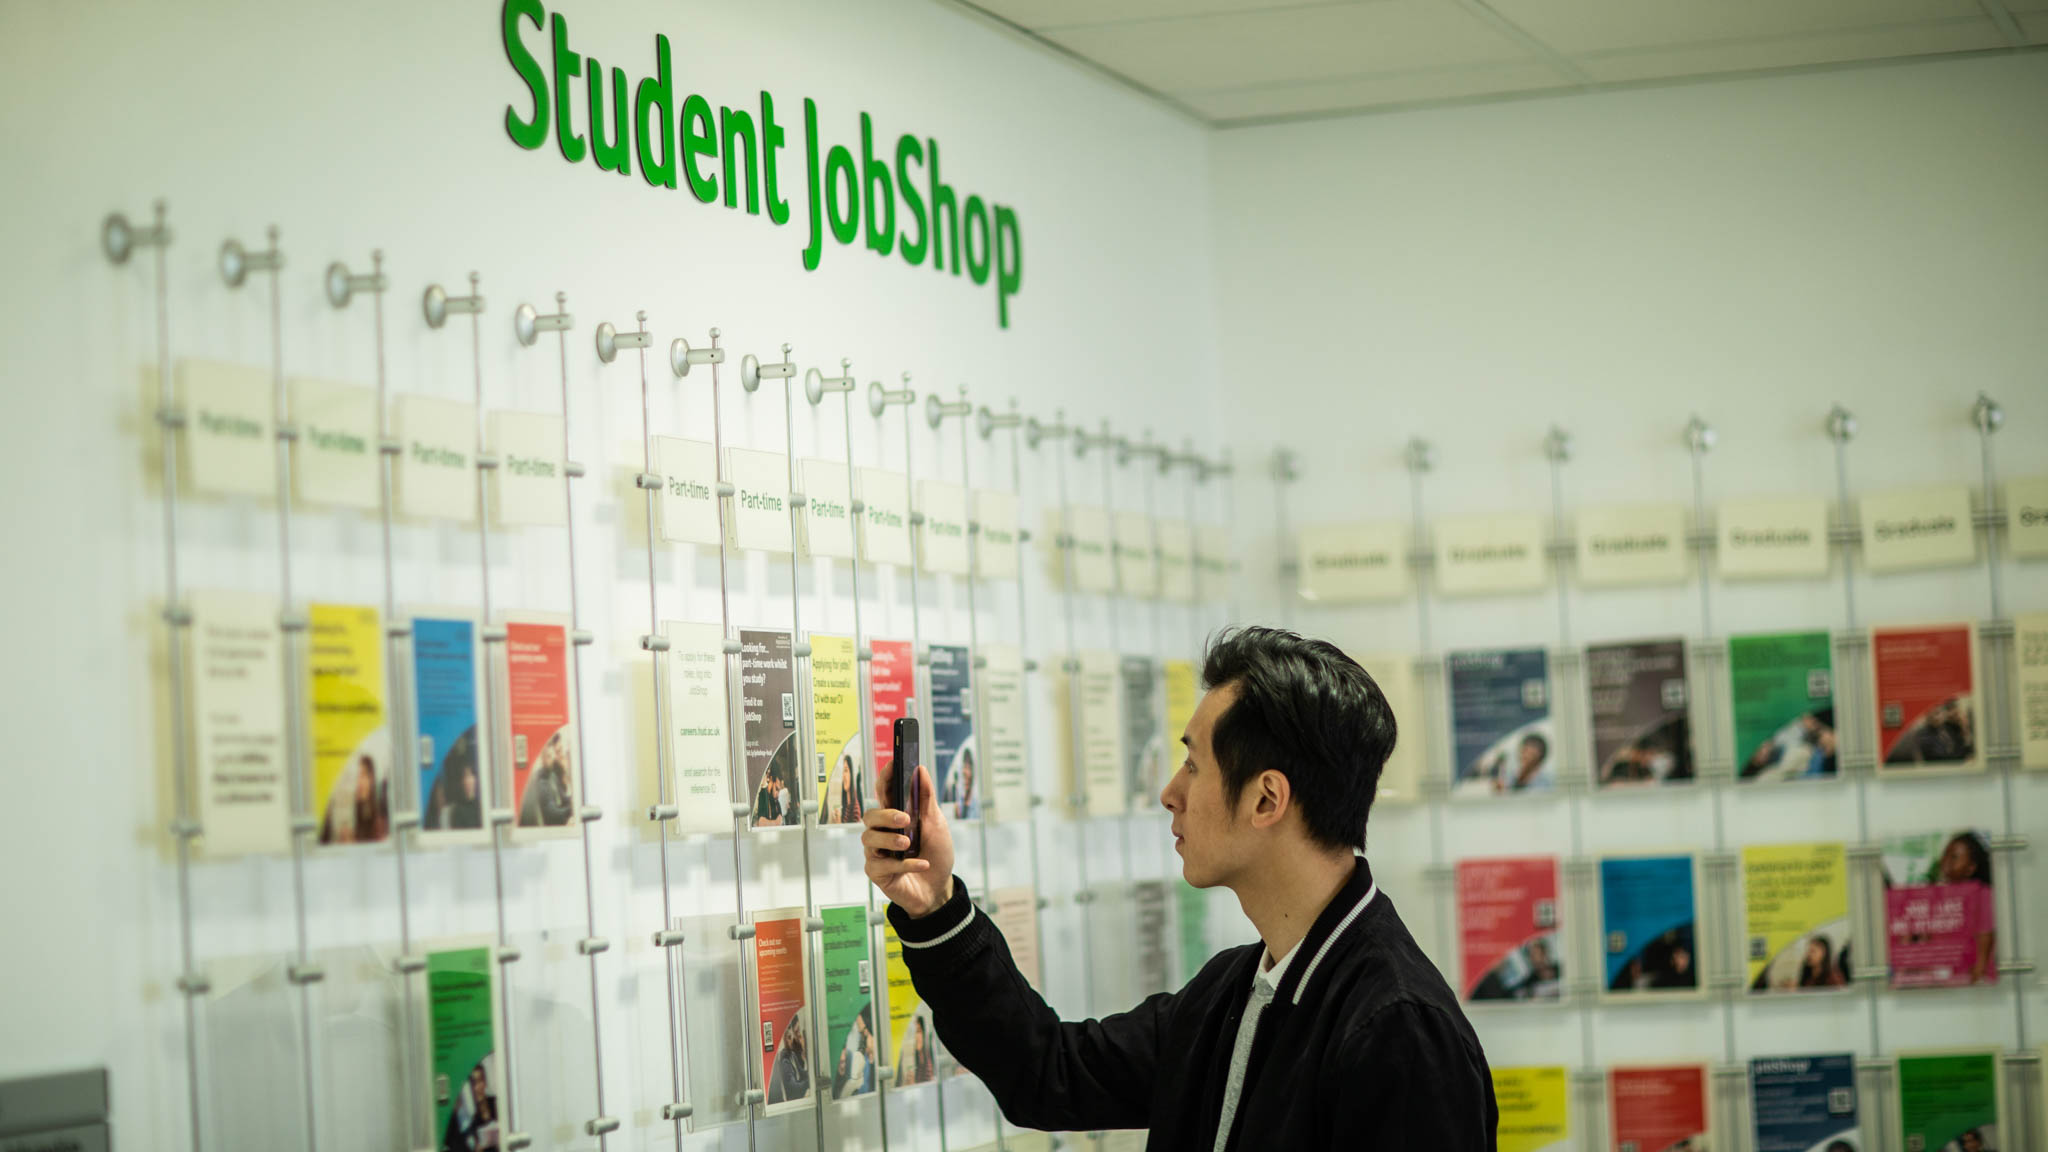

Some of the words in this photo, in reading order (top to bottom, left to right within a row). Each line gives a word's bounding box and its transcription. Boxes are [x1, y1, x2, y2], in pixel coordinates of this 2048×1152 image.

[502, 0, 790, 226] Student
[802, 97, 1022, 329] JobShop
[507, 453, 557, 479] Part-time
[668, 476, 711, 502] Part-time
[740, 488, 783, 513] Part-time
[811, 497, 846, 520] Part-time
[868, 504, 904, 528] Part-time
[1875, 516, 1956, 541] Graduate
[741, 642, 760, 656] Looking
[742, 658, 764, 670] part-time
[764, 659, 775, 669] work
[775, 658, 788, 669] whilst
[743, 674, 752, 686] you
[752, 673, 766, 686] study?
